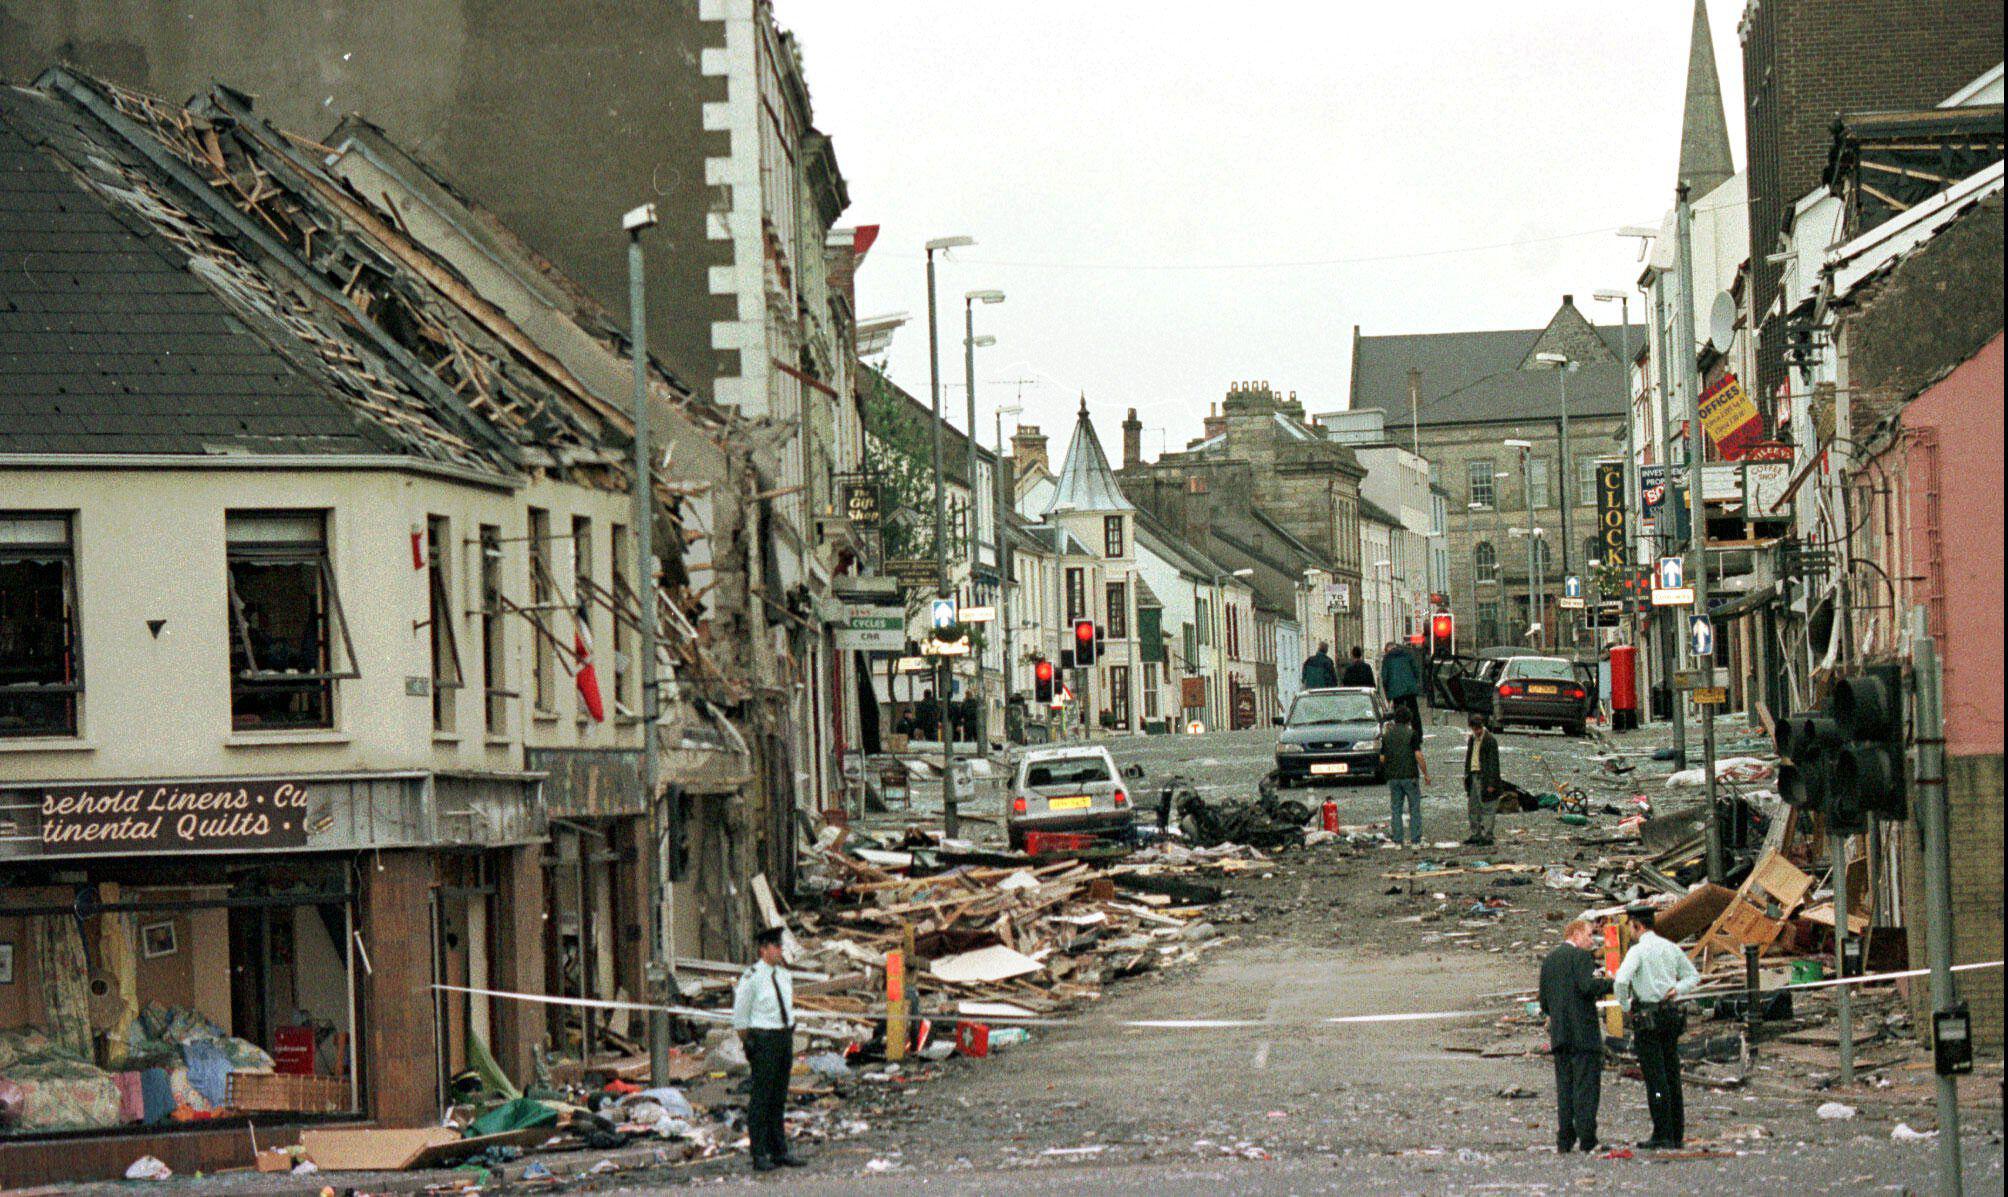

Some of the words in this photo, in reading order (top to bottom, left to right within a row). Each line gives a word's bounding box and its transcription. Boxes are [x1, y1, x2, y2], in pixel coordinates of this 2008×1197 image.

[1699, 386, 1740, 420] OFFICES
[1751, 464, 1782, 475] COFFEE
[1758, 472, 1777, 480] SHOP
[849, 497, 875, 510] Gift
[848, 510, 879, 522] Shop
[1604, 472, 1625, 564] CLOCK
[853, 618, 886, 628] CYCLES
[861, 632, 880, 640] CAR
[42, 789, 144, 815] sehold
[147, 787, 249, 811] Linens
[43, 817, 161, 843] tinental
[177, 813, 271, 840] Quilts
